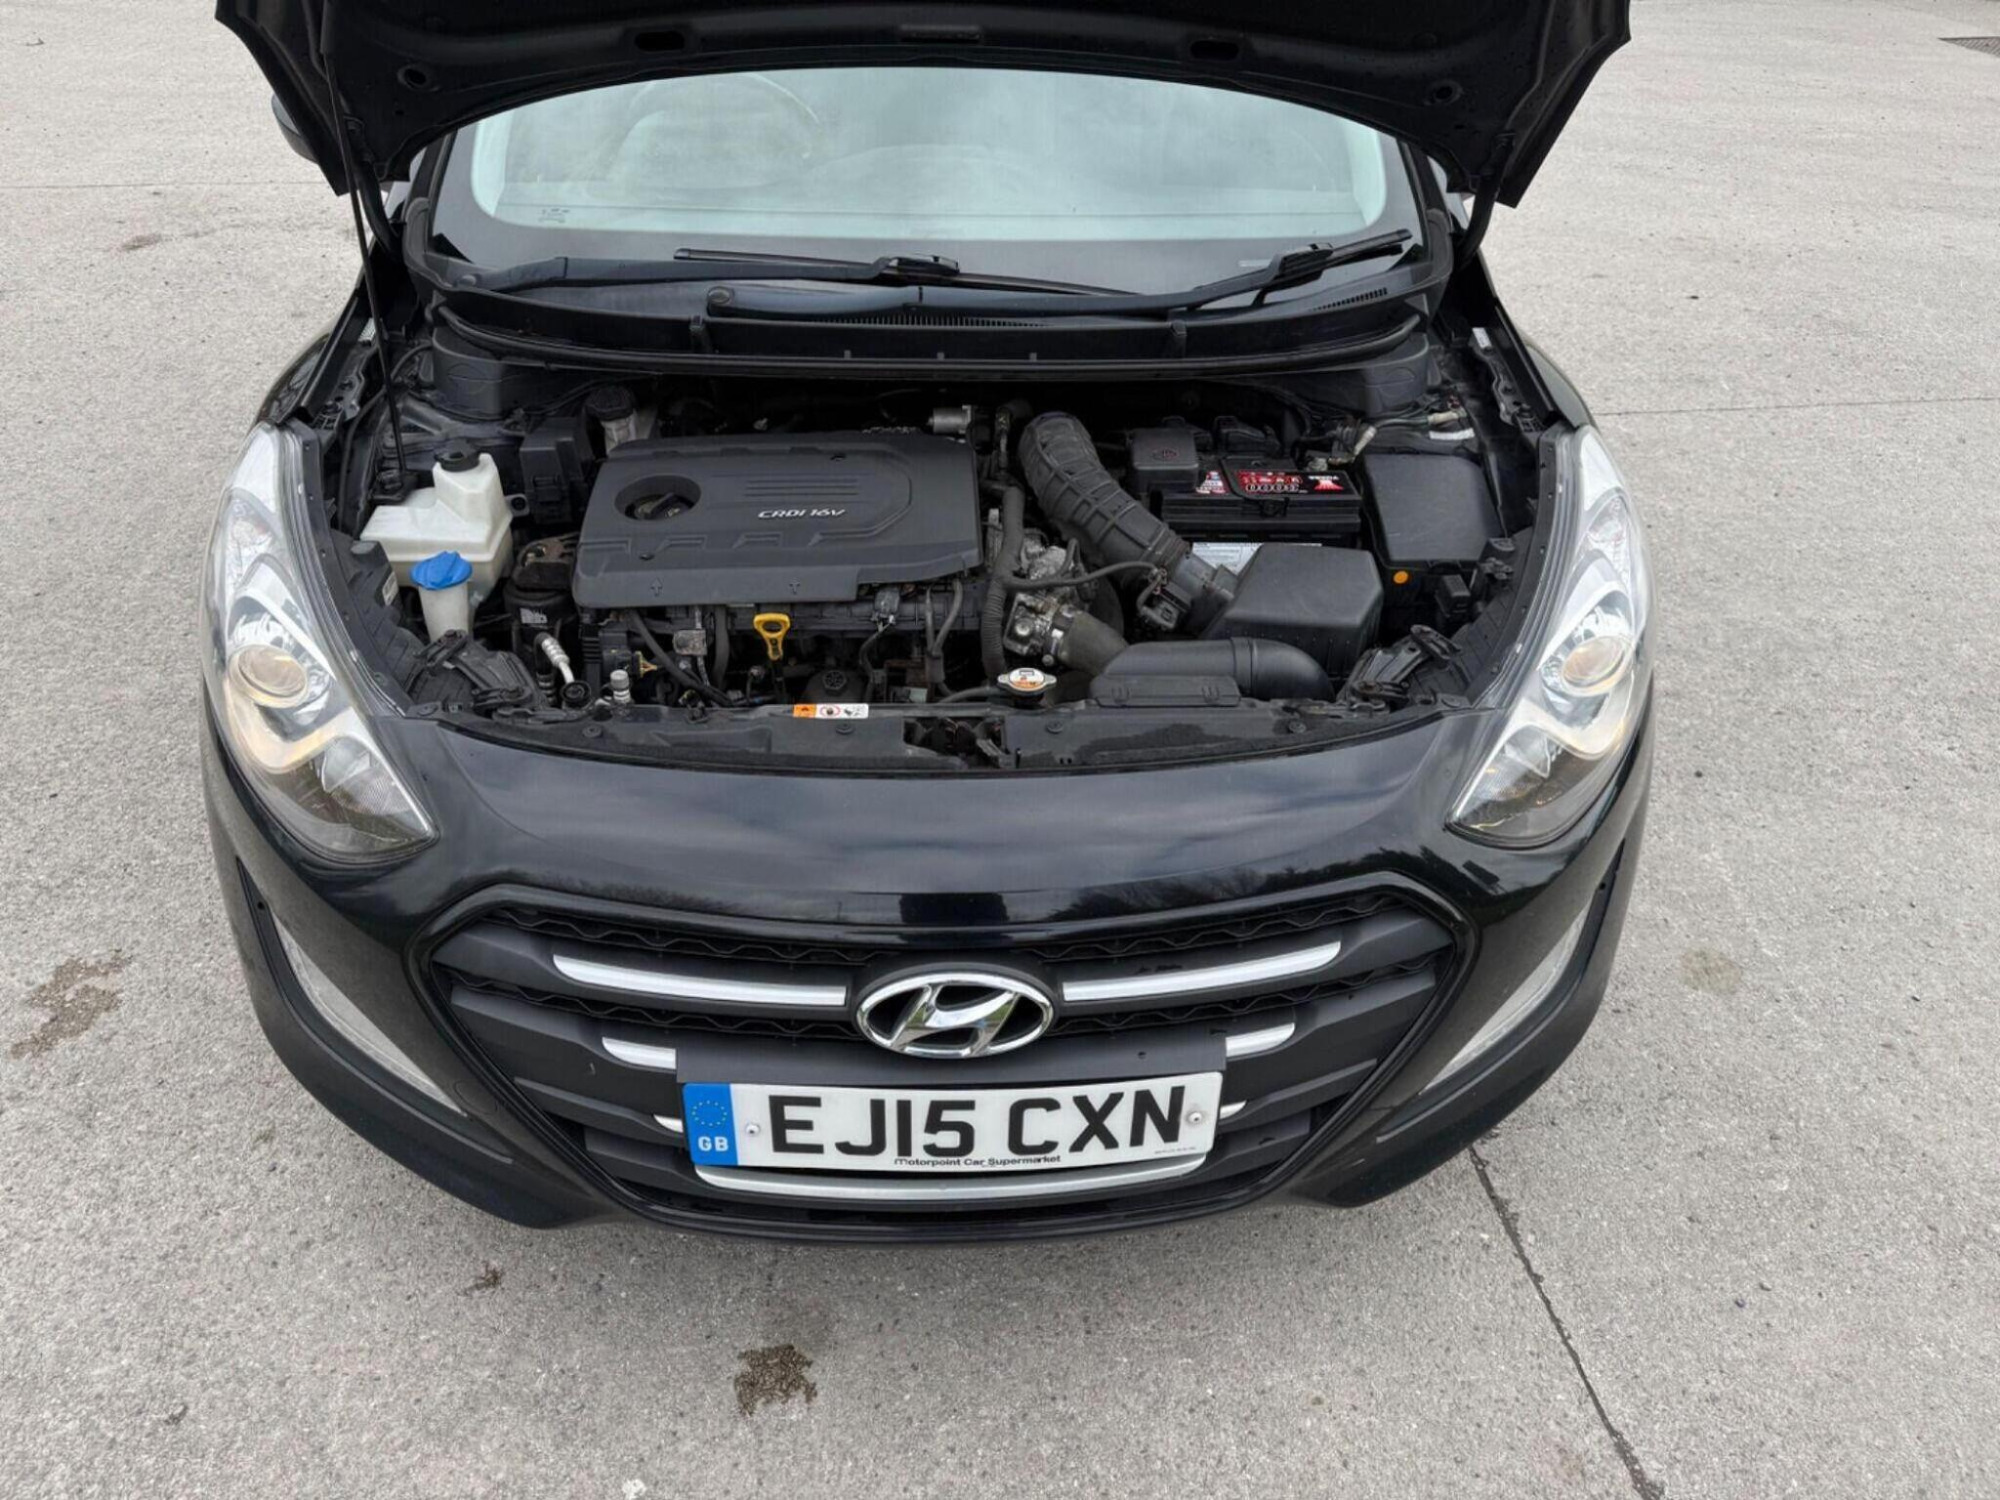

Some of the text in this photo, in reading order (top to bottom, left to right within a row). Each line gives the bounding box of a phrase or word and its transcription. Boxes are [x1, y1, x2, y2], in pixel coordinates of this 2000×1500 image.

[810, 508, 846, 517] 16V
[768, 1085, 1186, 1158] EJ15 CXN
[698, 1136, 729, 1152] GB
[964, 1157, 985, 1166] Car
[988, 1154, 1061, 1167] Supermarket
